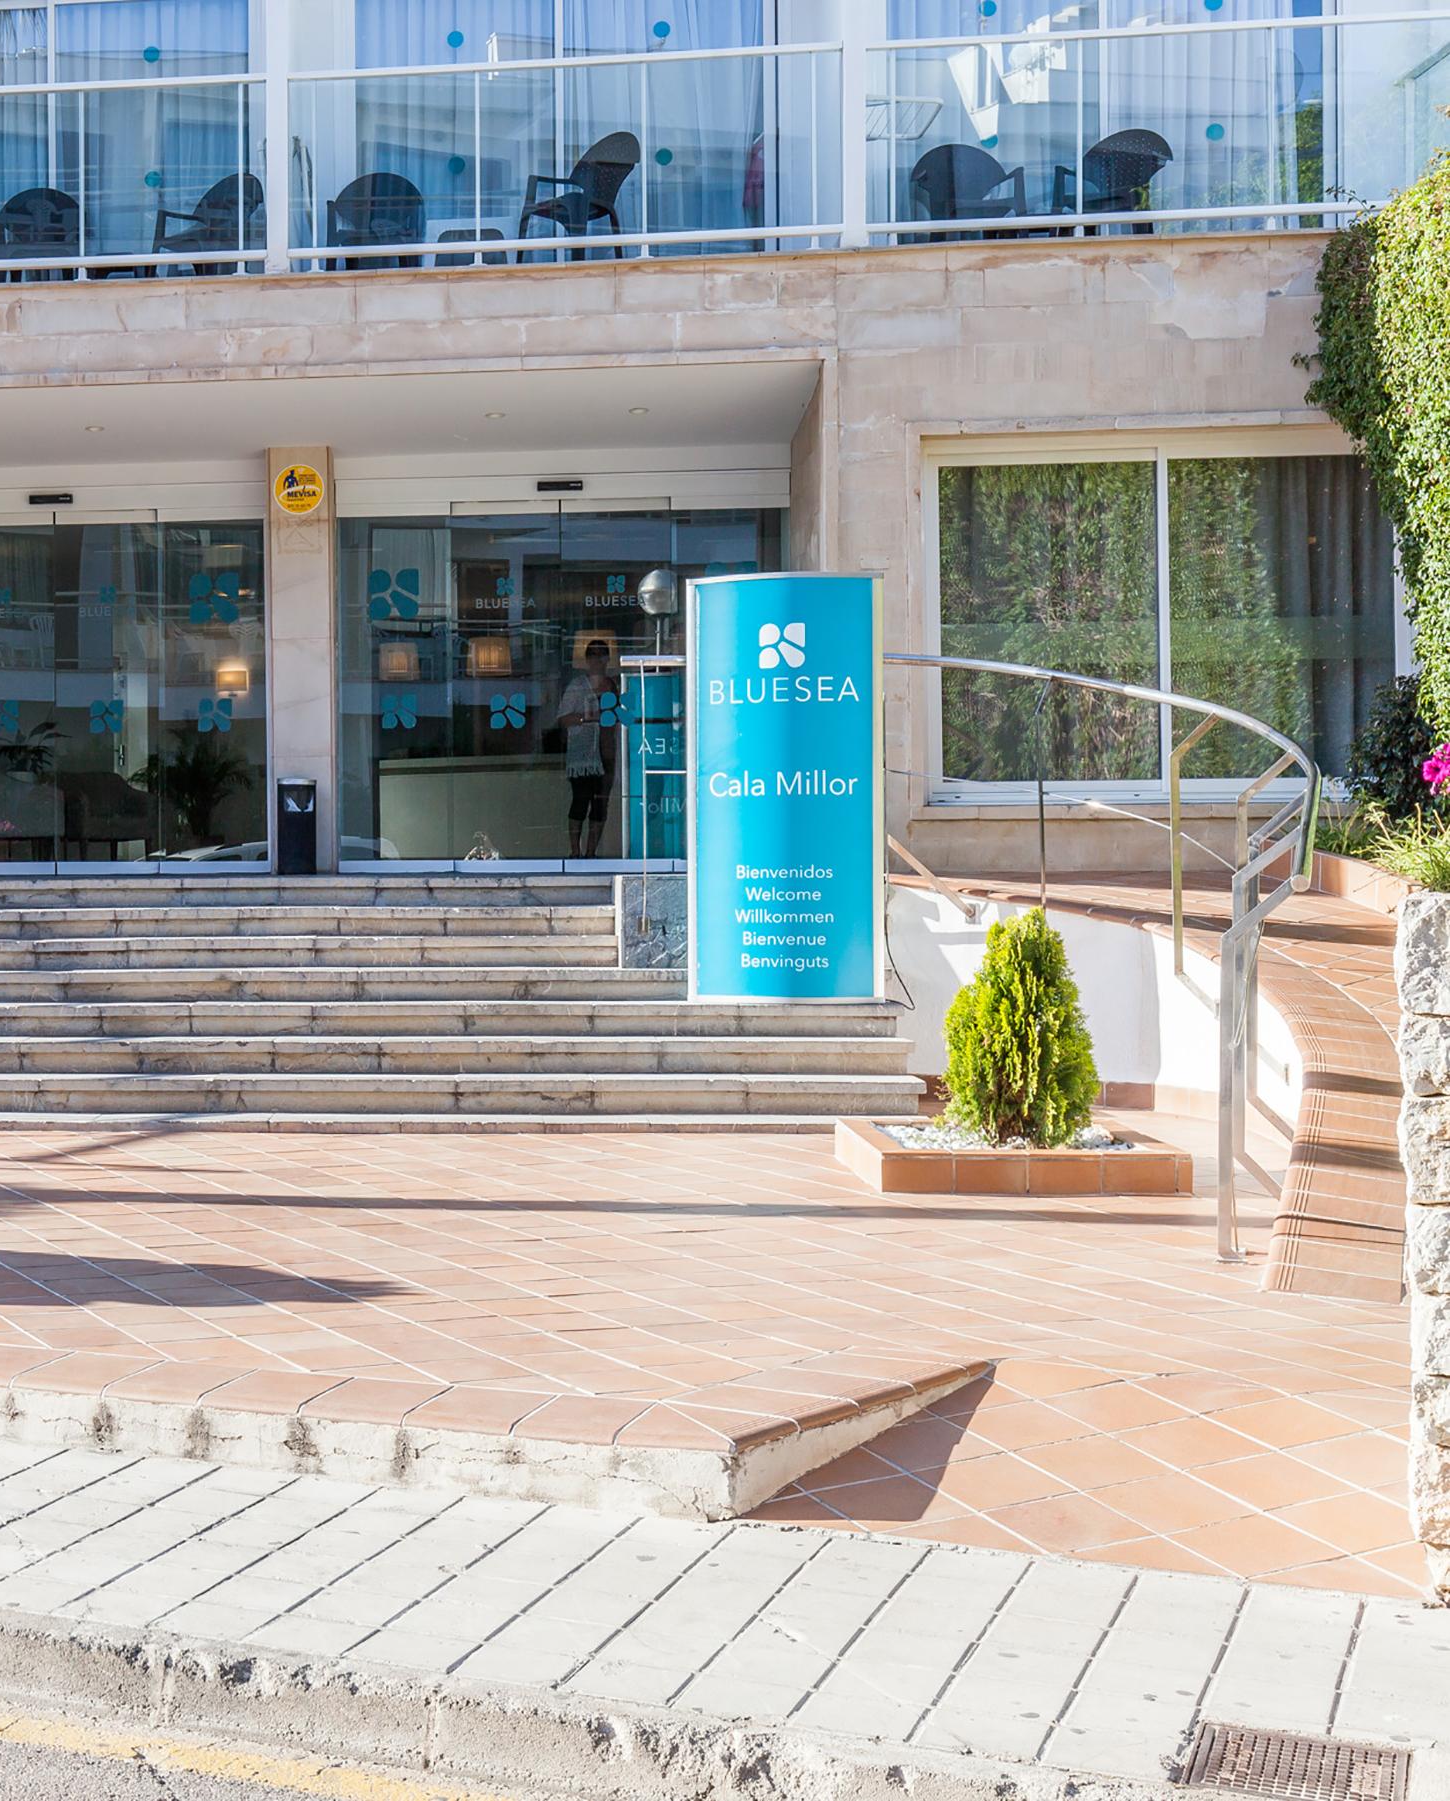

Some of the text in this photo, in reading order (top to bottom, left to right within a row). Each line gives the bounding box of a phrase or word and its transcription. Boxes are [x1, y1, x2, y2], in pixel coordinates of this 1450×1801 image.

[475, 598, 537, 609] BLUEEA
[709, 676, 860, 705] BLUESEA
[709, 769, 859, 798] Cala Millor
[736, 864, 833, 879] Bienvenidos
[745, 887, 822, 901] Welcome
[734, 908, 834, 923] Willkommen
[742, 931, 827, 946] Bienvenue
[741, 953, 830, 972] Benvinguts
